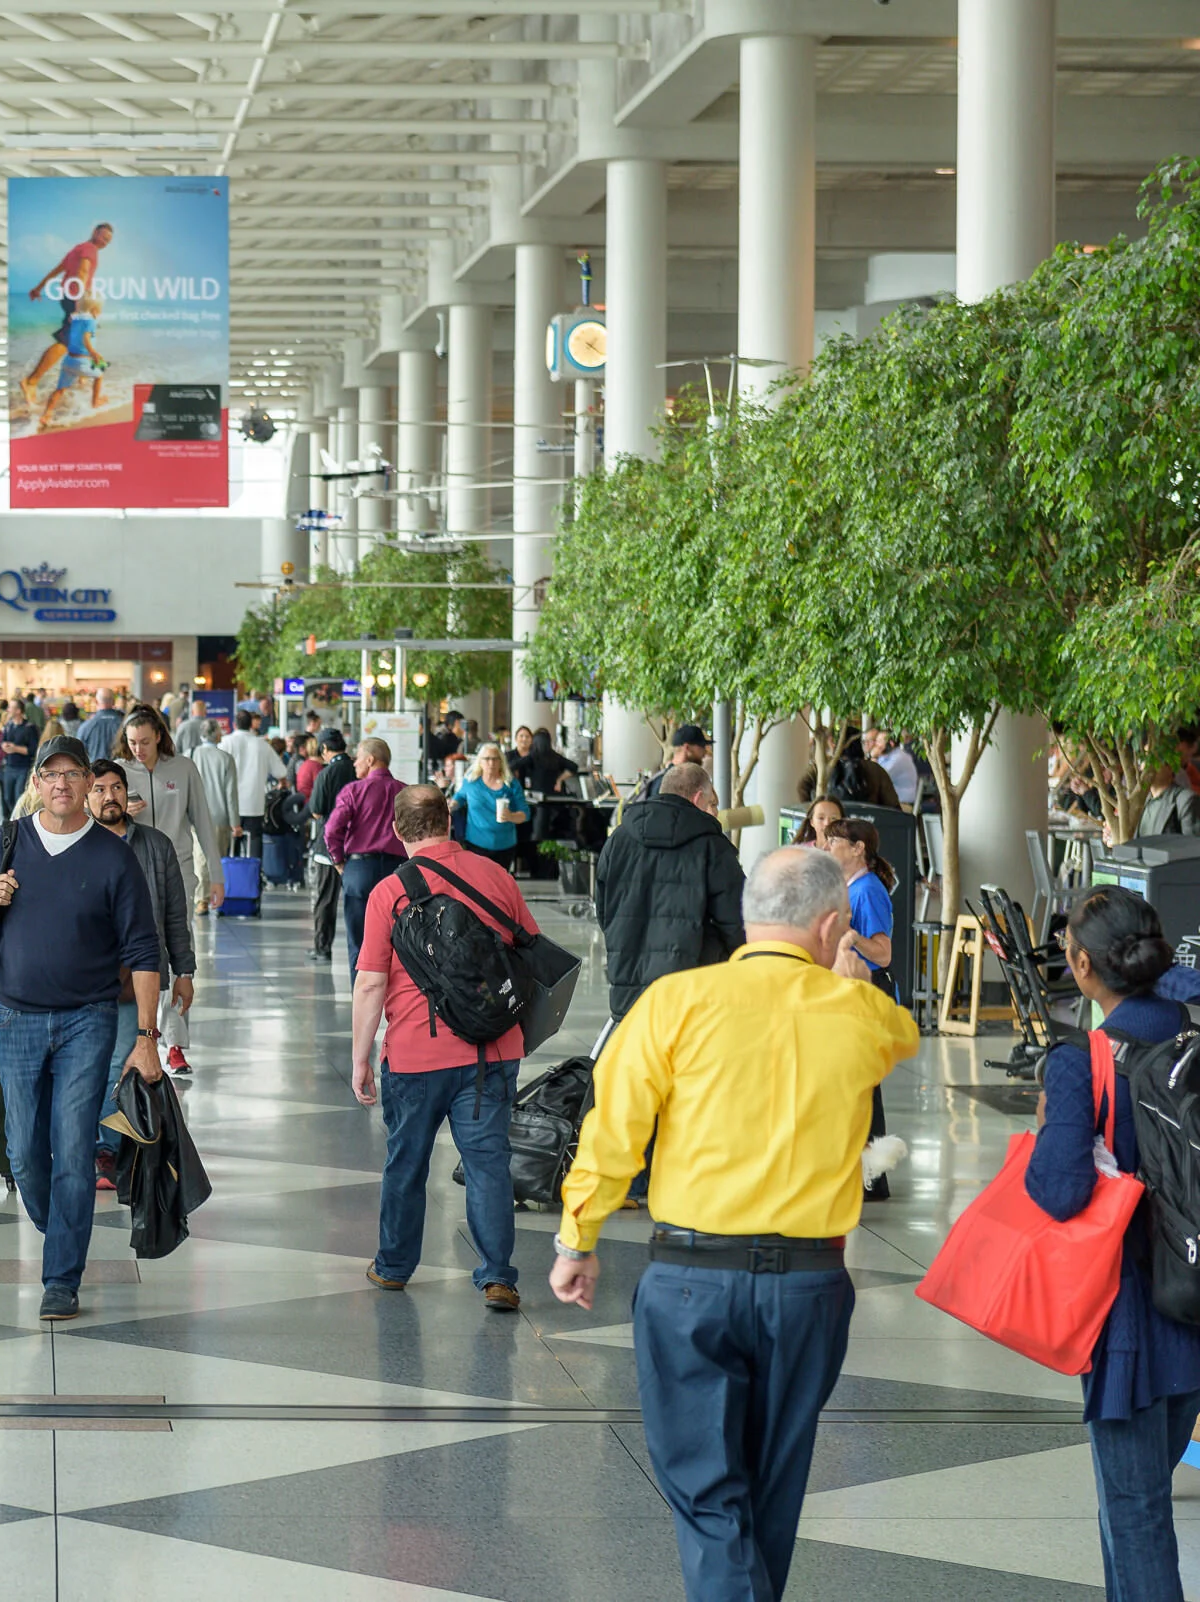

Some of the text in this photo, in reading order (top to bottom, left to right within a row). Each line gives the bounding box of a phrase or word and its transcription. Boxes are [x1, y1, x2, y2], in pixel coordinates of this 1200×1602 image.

[44, 276, 220, 301] GO RUN WILD
[16, 464, 38, 473] YOUR
[60, 463, 74, 472] TRIP
[76, 463, 103, 472] STARTS
[104, 463, 122, 471] HERE
[16, 477, 110, 493] ApplyAviator.com
[71, 588, 112, 604] CITY
